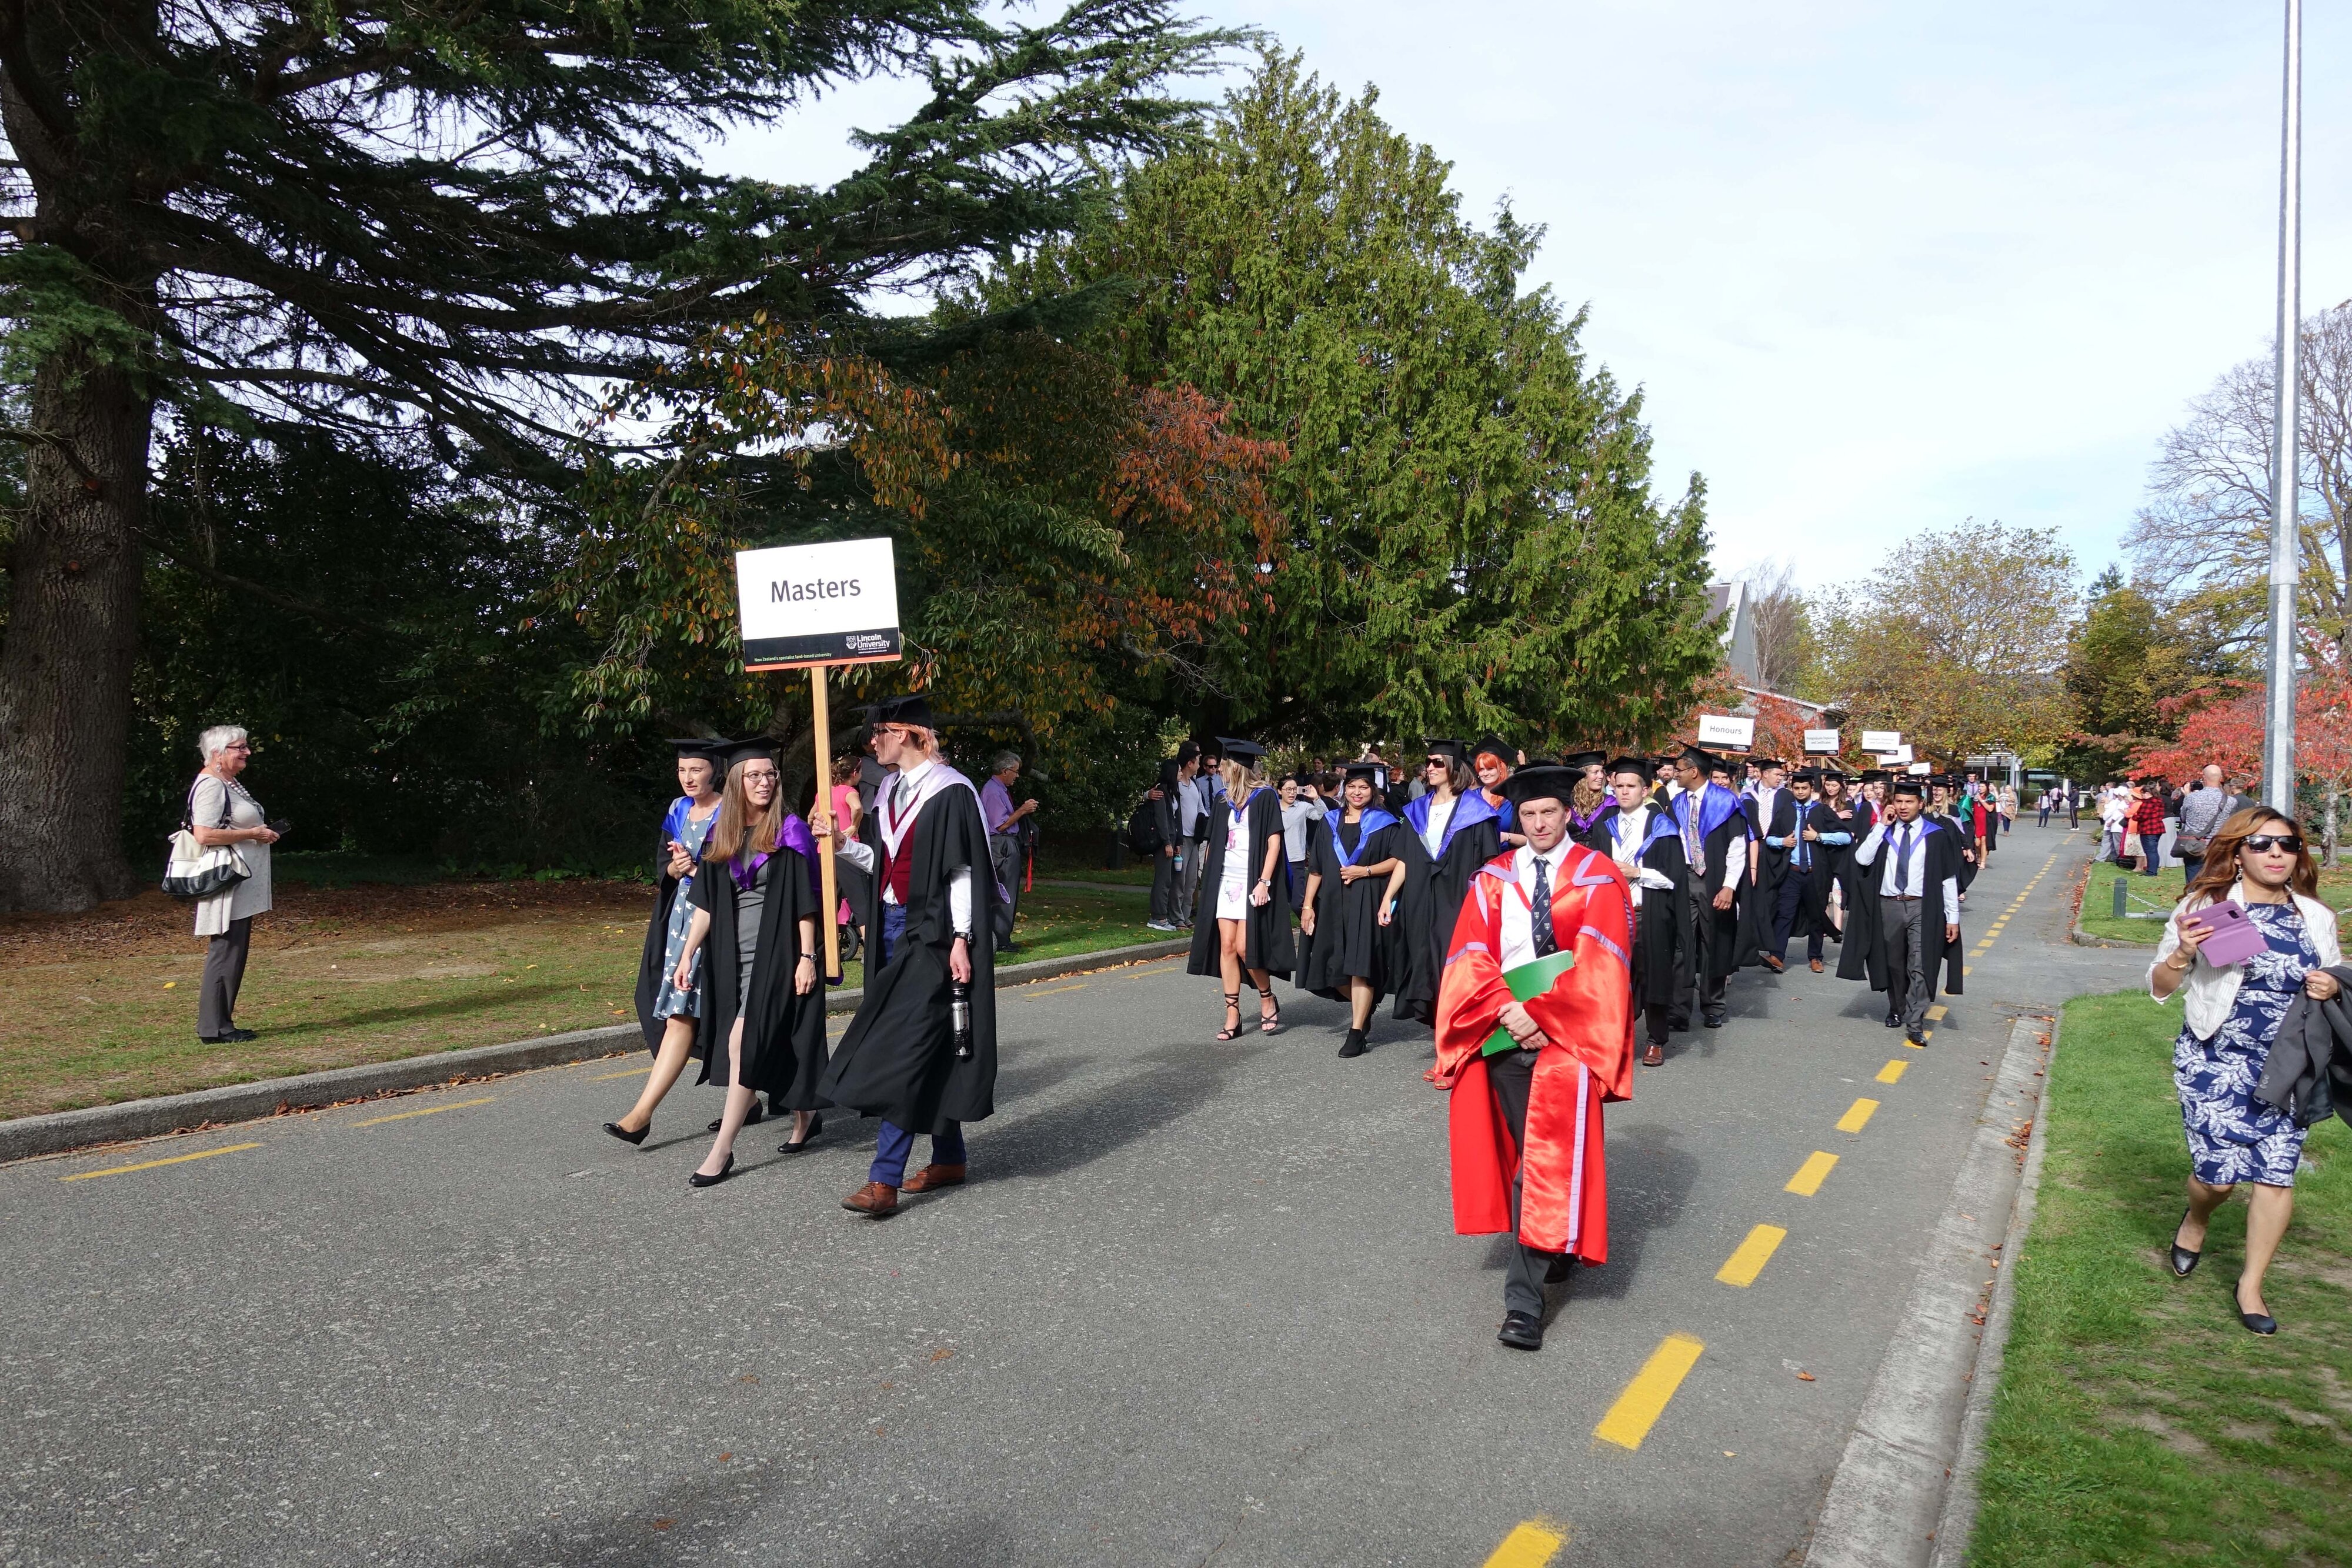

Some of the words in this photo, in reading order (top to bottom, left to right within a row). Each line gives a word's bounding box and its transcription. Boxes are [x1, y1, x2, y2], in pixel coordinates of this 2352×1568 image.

[771, 578, 861, 603] Masters
[856, 633, 882, 642] Lincoln
[857, 639, 890, 649] University
[1710, 725, 1742, 735] Honours
